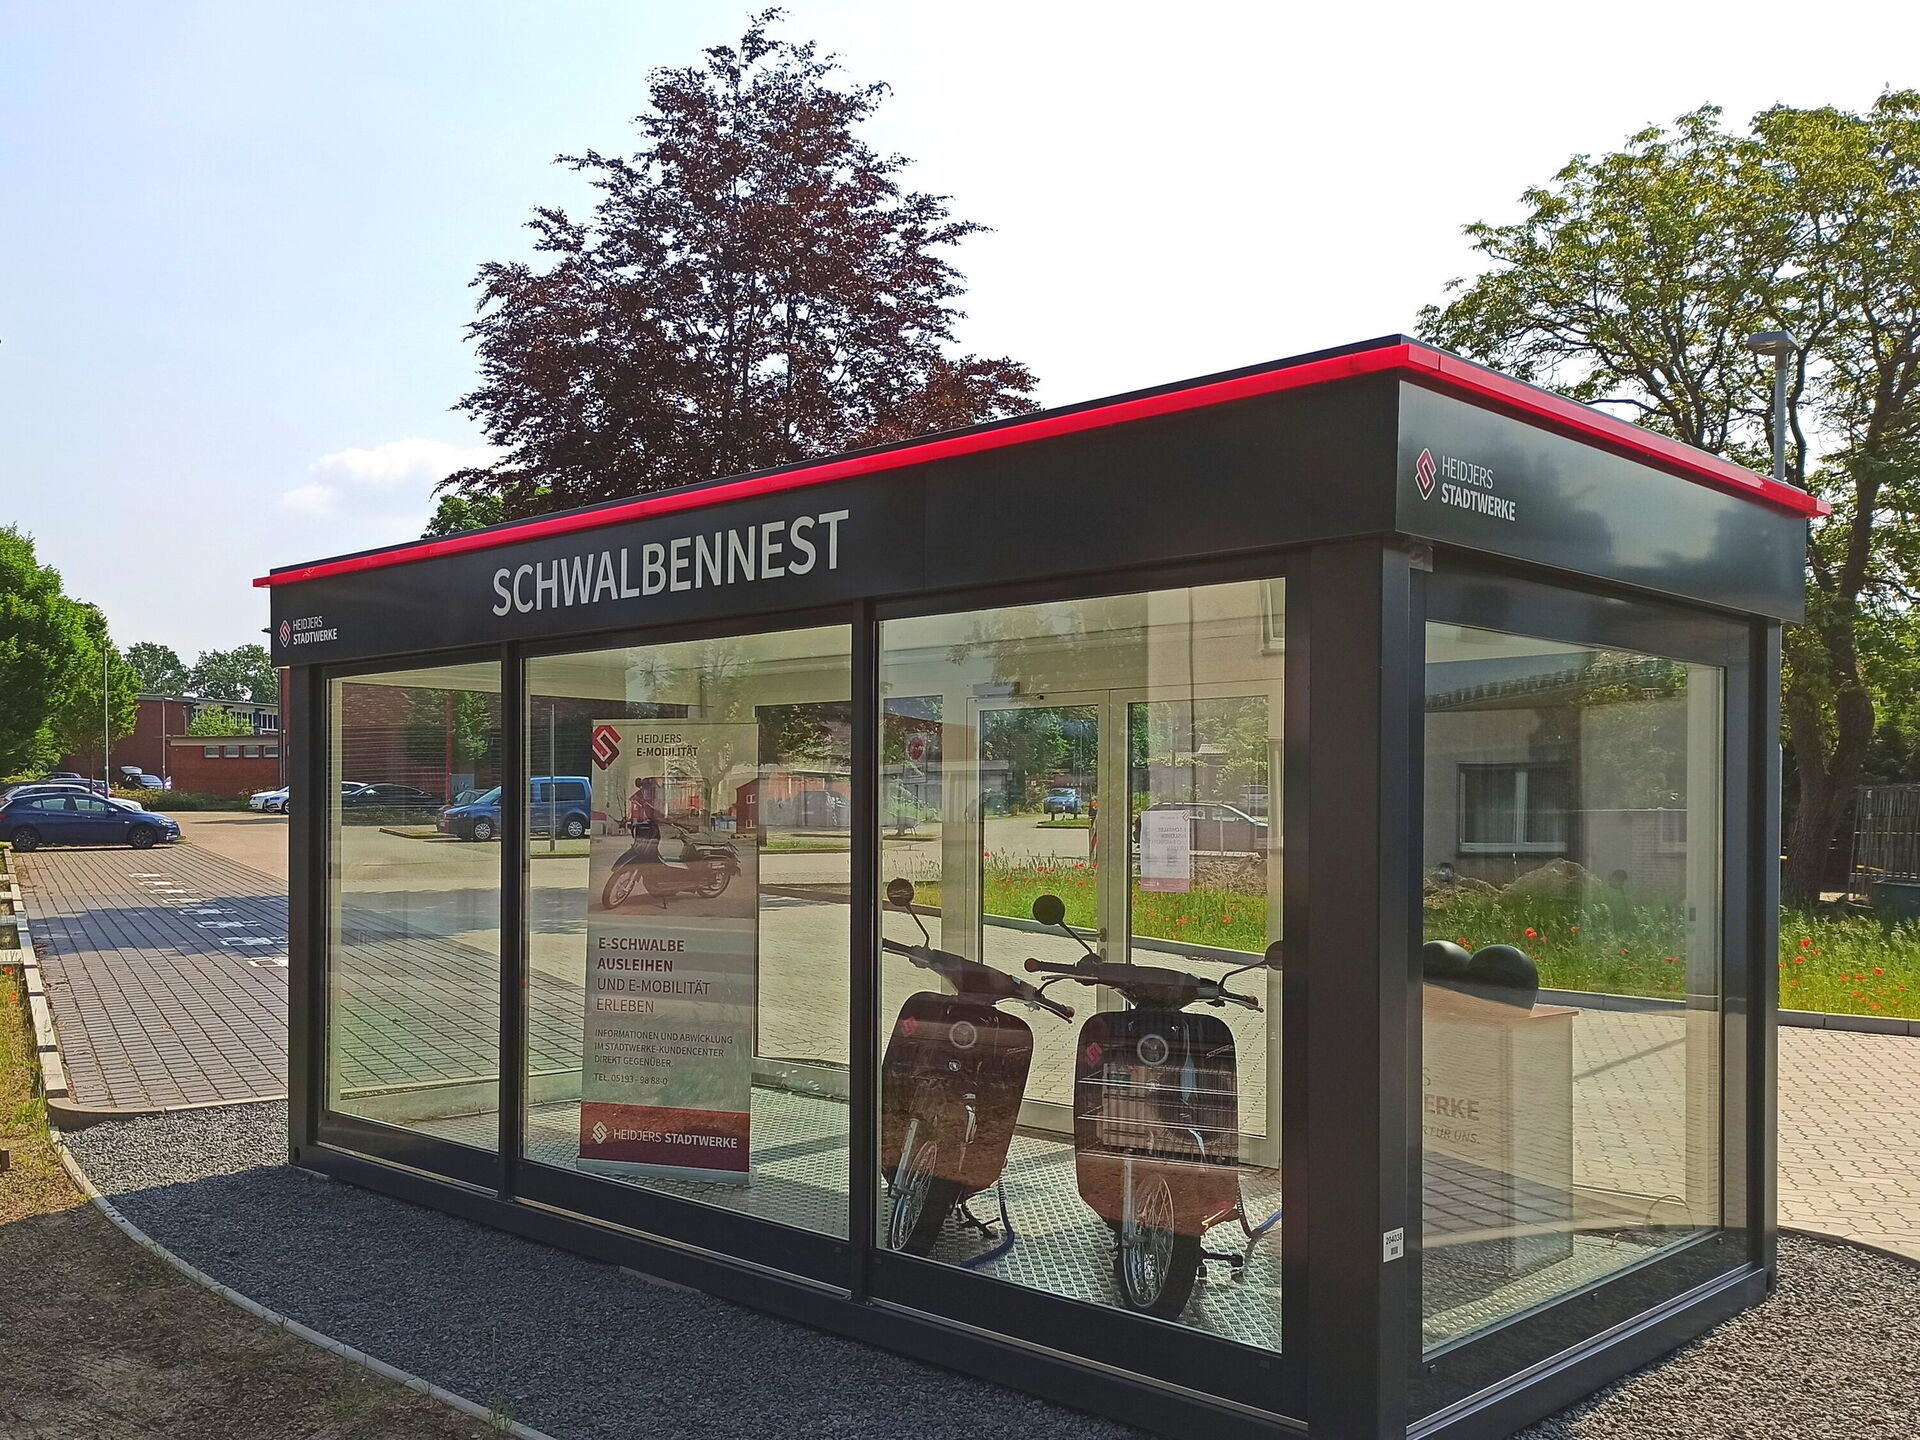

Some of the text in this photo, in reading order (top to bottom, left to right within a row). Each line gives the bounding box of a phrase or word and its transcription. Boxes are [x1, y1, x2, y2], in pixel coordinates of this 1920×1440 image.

[1442, 455, 1494, 489] HEIDJERS
[1441, 482, 1516, 521] STADTWERKE
[492, 509, 849, 616] SCHWALBENNEST
[292, 615, 323, 631] HEIDJERS
[293, 628, 338, 645] STADTWERKE
[636, 733, 682, 744] HEIDJERS
[636, 744, 698, 757] E-MOBILITÄT
[598, 937, 685, 952] E-SCHWALBE
[597, 957, 673, 972] AUSLEIHEN
[597, 977, 711, 995] UND E-MOBILITÄT
[596, 998, 654, 1013] ERLEBEN
[595, 1028, 733, 1045] INFORMATIONEN UND ABWICKLUNG
[594, 1042, 724, 1057] IM STADTWERKE-KUNDENCENTER
[594, 1055, 621, 1065] DIREKT
[594, 1072, 609, 1082] TEL.
[611, 1074, 634, 1084] 05193
[613, 1128, 738, 1149] HEIDJERS STADTWERKE
